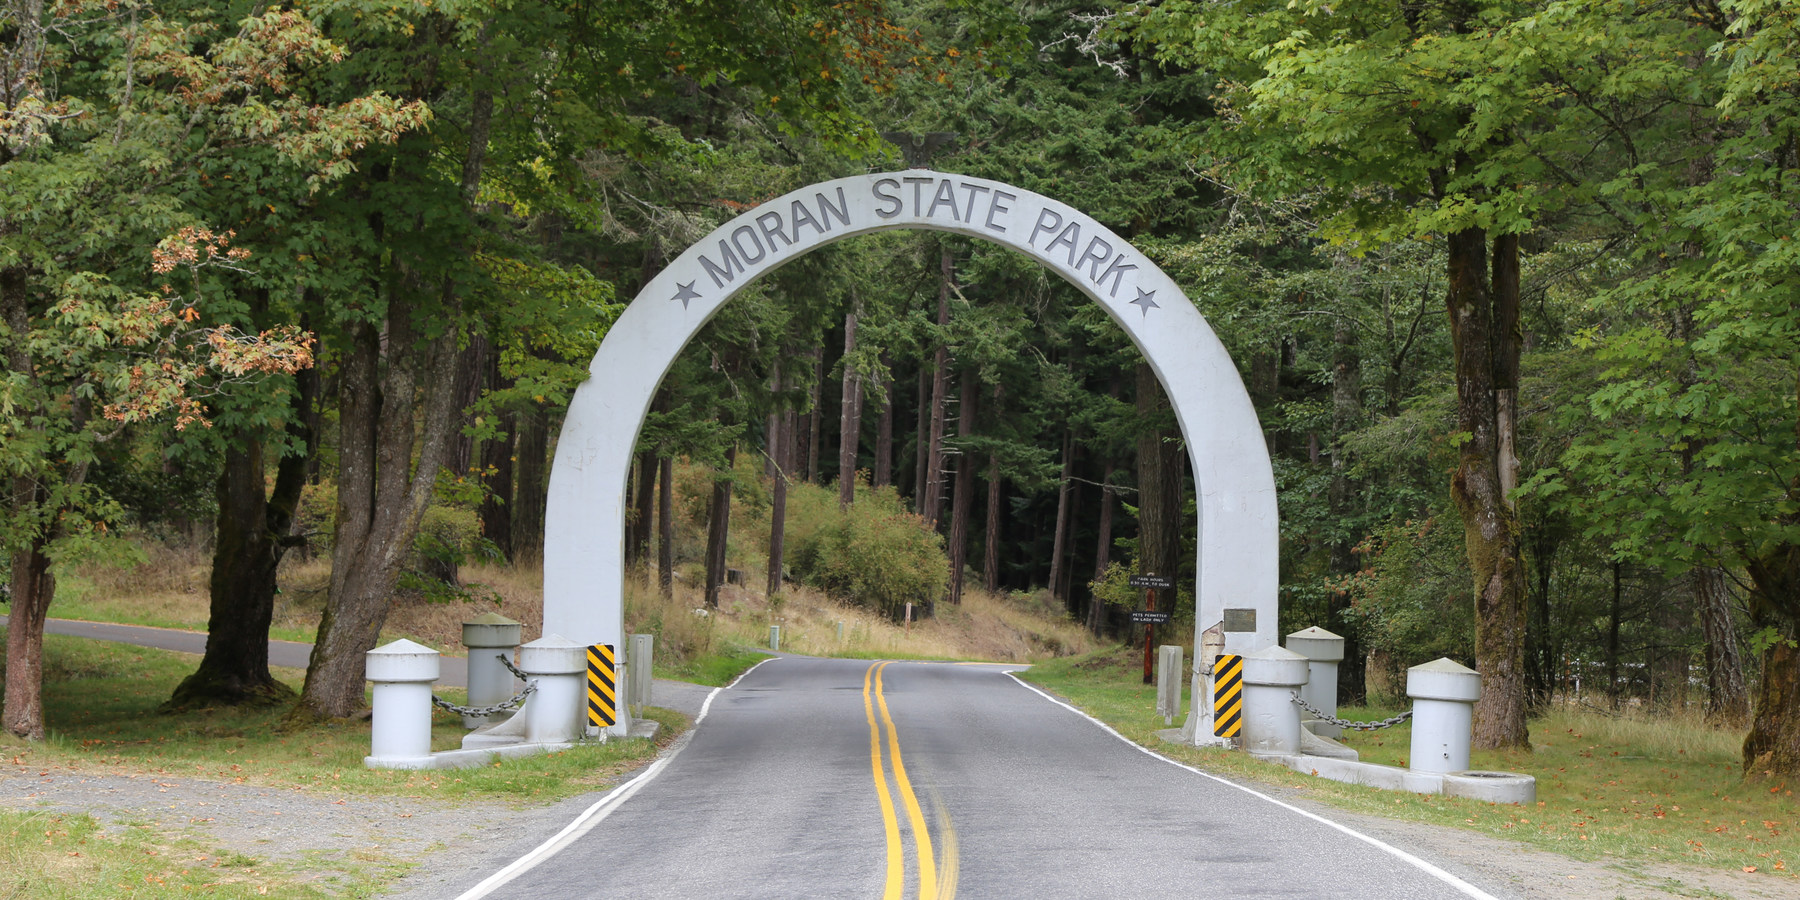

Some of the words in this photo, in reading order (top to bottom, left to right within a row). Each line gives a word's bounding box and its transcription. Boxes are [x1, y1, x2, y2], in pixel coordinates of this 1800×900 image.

[697, 187, 850, 289] MORAN
[872, 177, 1017, 233] STATE
[1028, 207, 1139, 298] PARK
